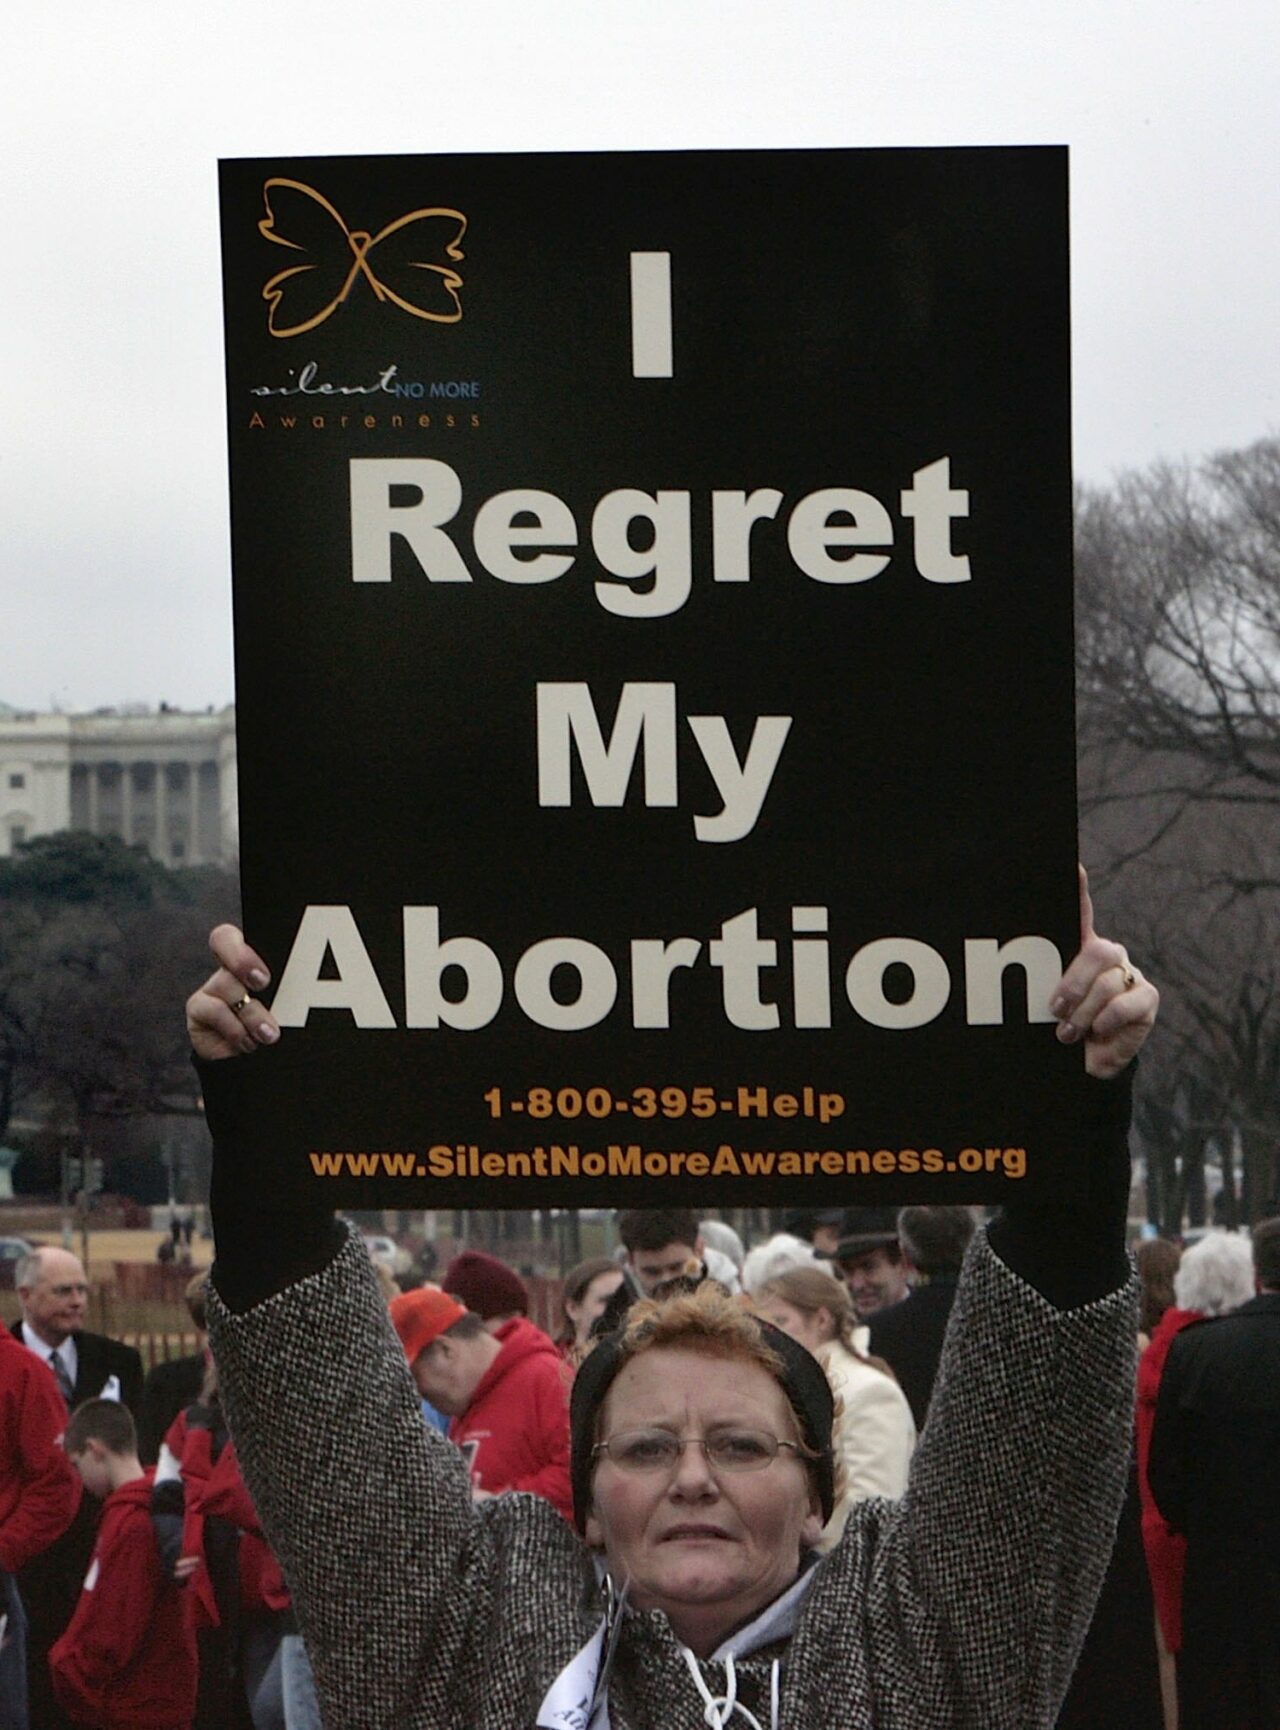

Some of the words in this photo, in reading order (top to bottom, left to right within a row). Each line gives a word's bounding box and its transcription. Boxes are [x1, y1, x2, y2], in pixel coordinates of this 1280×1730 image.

[630, 251, 673, 378] I
[249, 412, 480, 429] Awareness
[250, 361, 398, 397] silent
[395, 382, 424, 398] NO
[430, 381, 480, 398] MORE
[349, 456, 972, 618] Regret
[536, 681, 792, 843] My
[270, 904, 1065, 1032] Abortion
[484, 1087, 845, 1122] 1-800-395-Help
[309, 1145, 1026, 1179] www.SilentNoMoreAwareness.org
